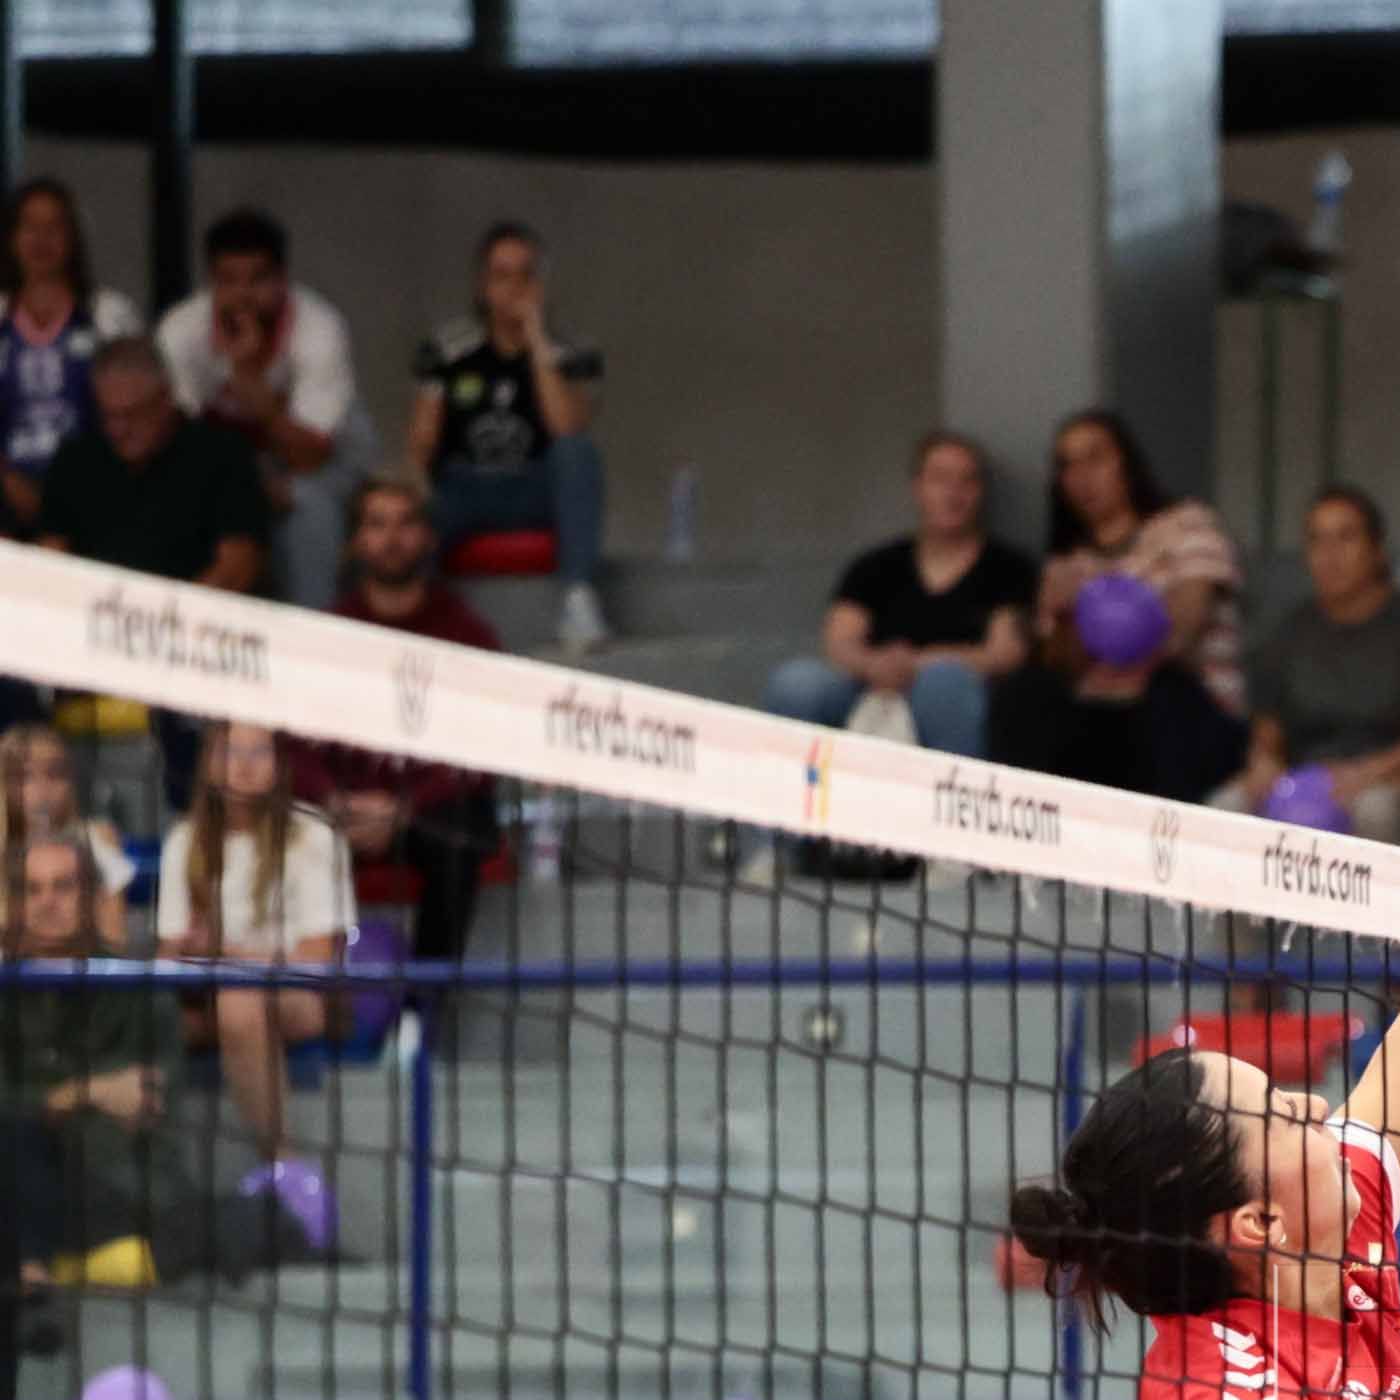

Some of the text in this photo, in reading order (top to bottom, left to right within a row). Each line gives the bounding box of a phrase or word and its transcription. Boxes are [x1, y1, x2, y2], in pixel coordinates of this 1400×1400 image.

[88, 591, 270, 681] rfevb.com
[547, 681, 697, 774] rfevb.com
[935, 767, 1061, 846] rfevb.com
[1262, 830, 1373, 906] rfevb.com
